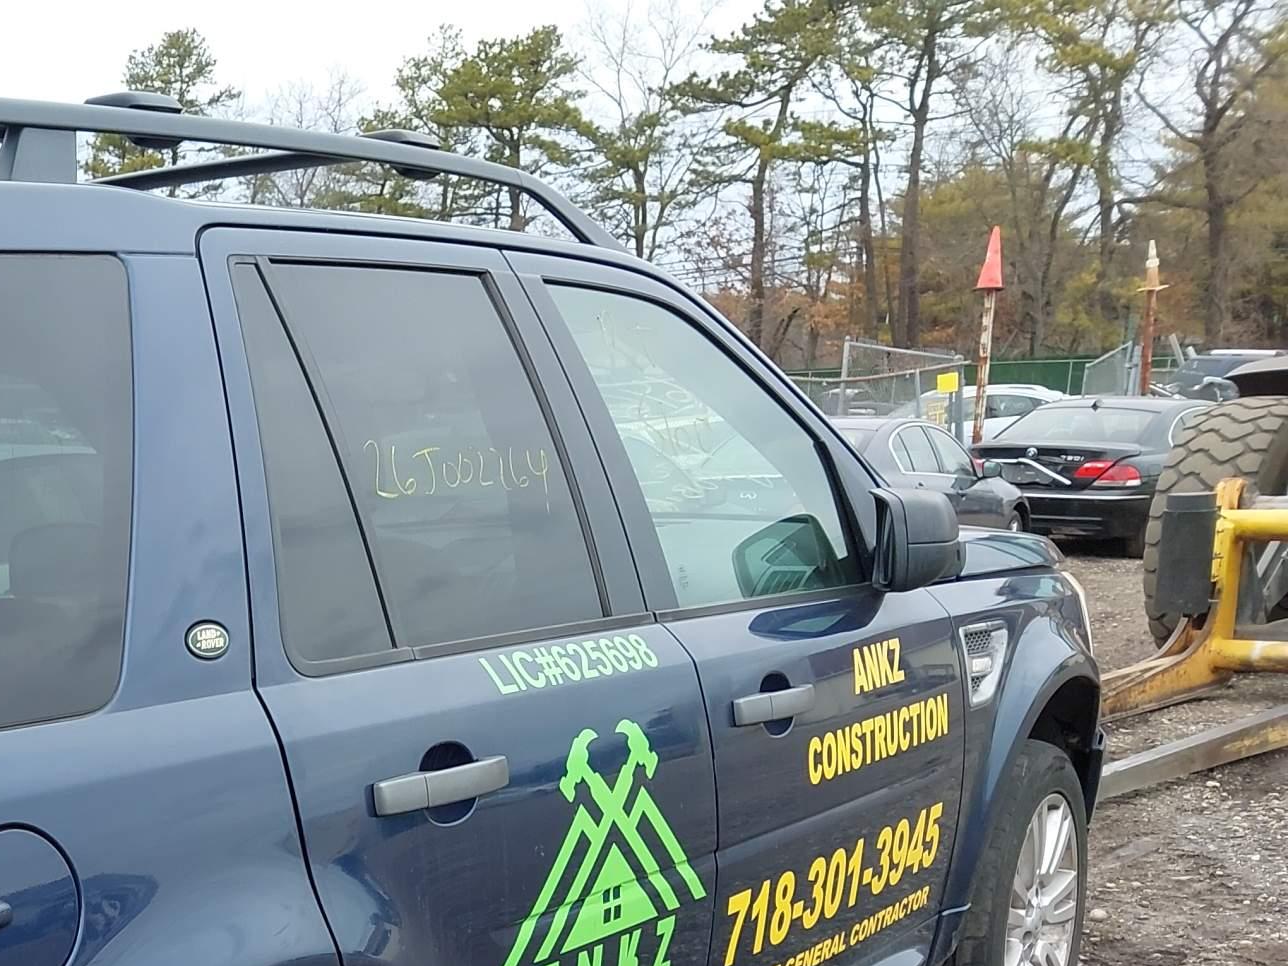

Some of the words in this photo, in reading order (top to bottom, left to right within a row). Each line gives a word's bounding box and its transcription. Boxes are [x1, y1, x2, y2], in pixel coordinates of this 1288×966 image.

[196, 628, 217, 641] LAND
[201, 637, 225, 650] ROVER
[478, 633, 659, 695] LIC#625698
[853, 637, 906, 695] ANKZ
[808, 692, 949, 786] CONSTRUCTION
[849, 885, 931, 947] CONTRACTOR
